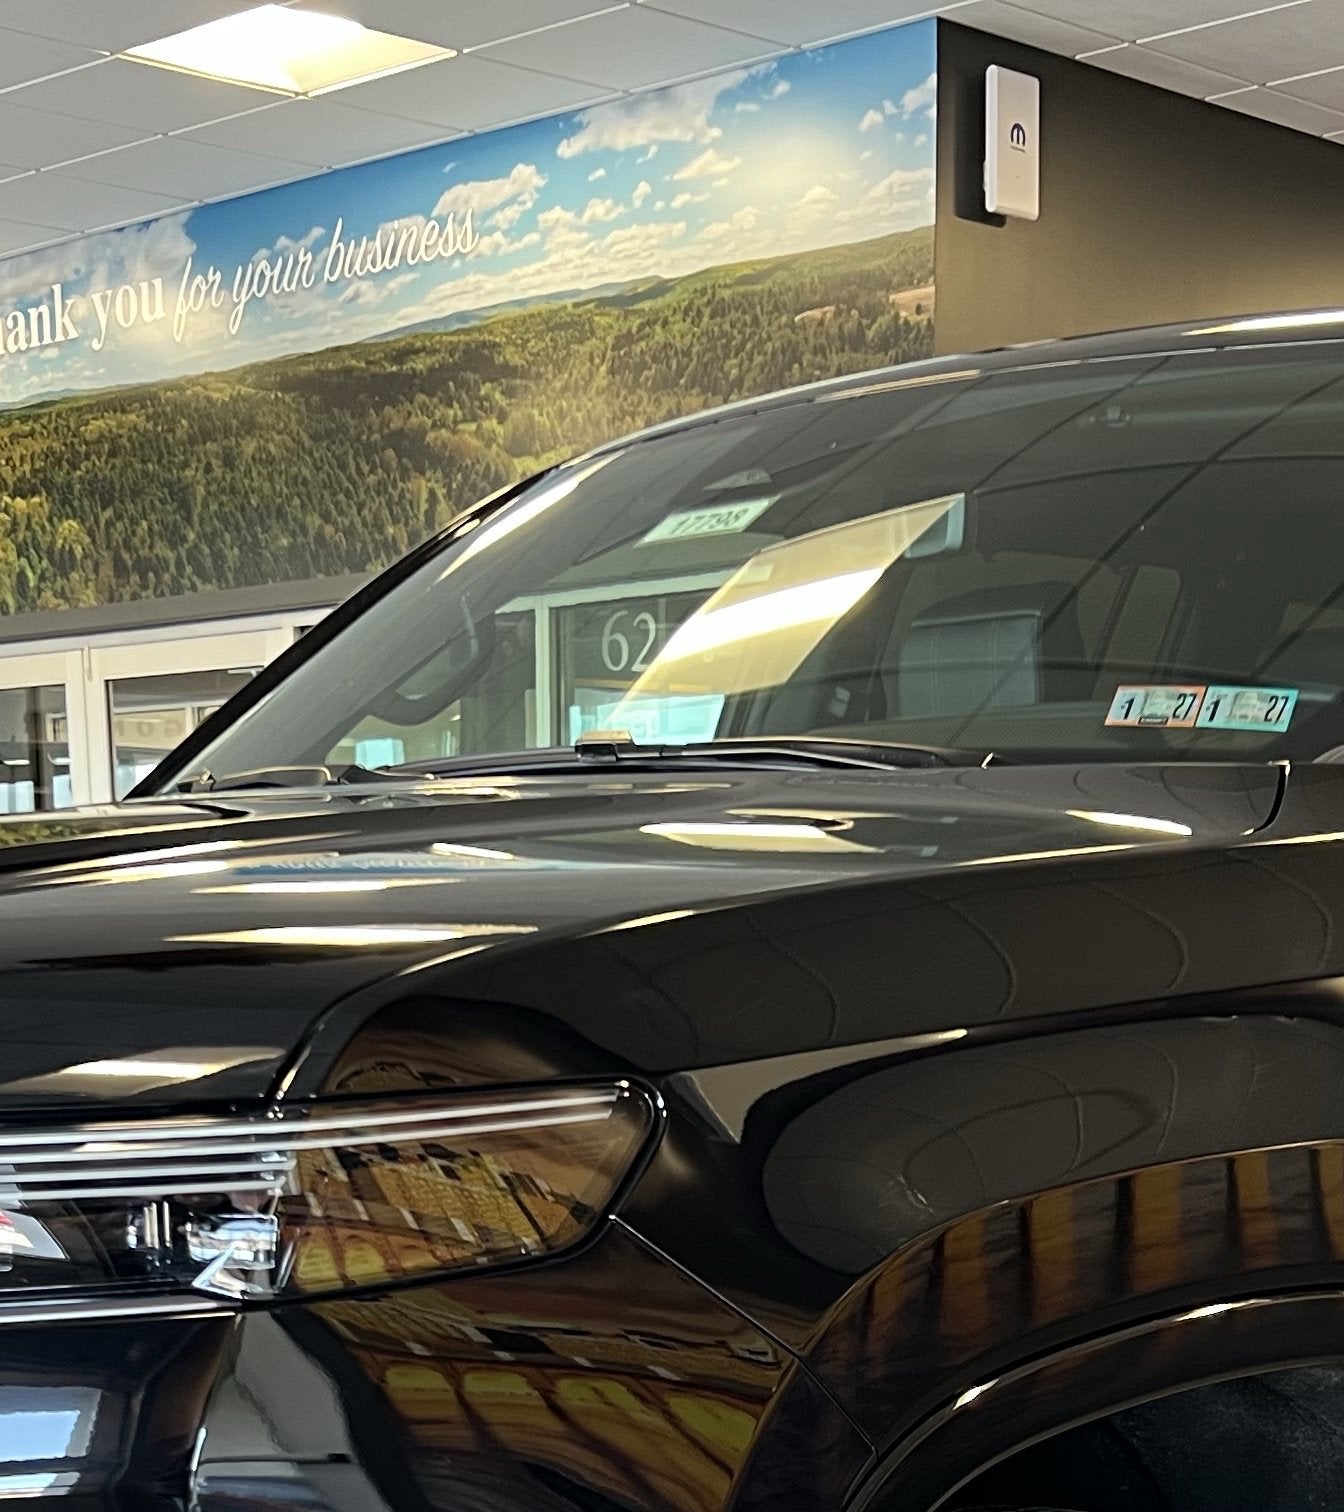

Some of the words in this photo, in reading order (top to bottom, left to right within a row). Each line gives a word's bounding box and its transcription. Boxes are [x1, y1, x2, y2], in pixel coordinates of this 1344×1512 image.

[90, 276, 164, 351] you
[173, 256, 224, 342] for
[230, 251, 316, 334] your
[324, 206, 481, 283] business
[1122, 697, 1136, 721] 1
[1172, 693, 1198, 721] 27
[1208, 699, 1222, 723] 1
[1264, 695, 1290, 724] 27
